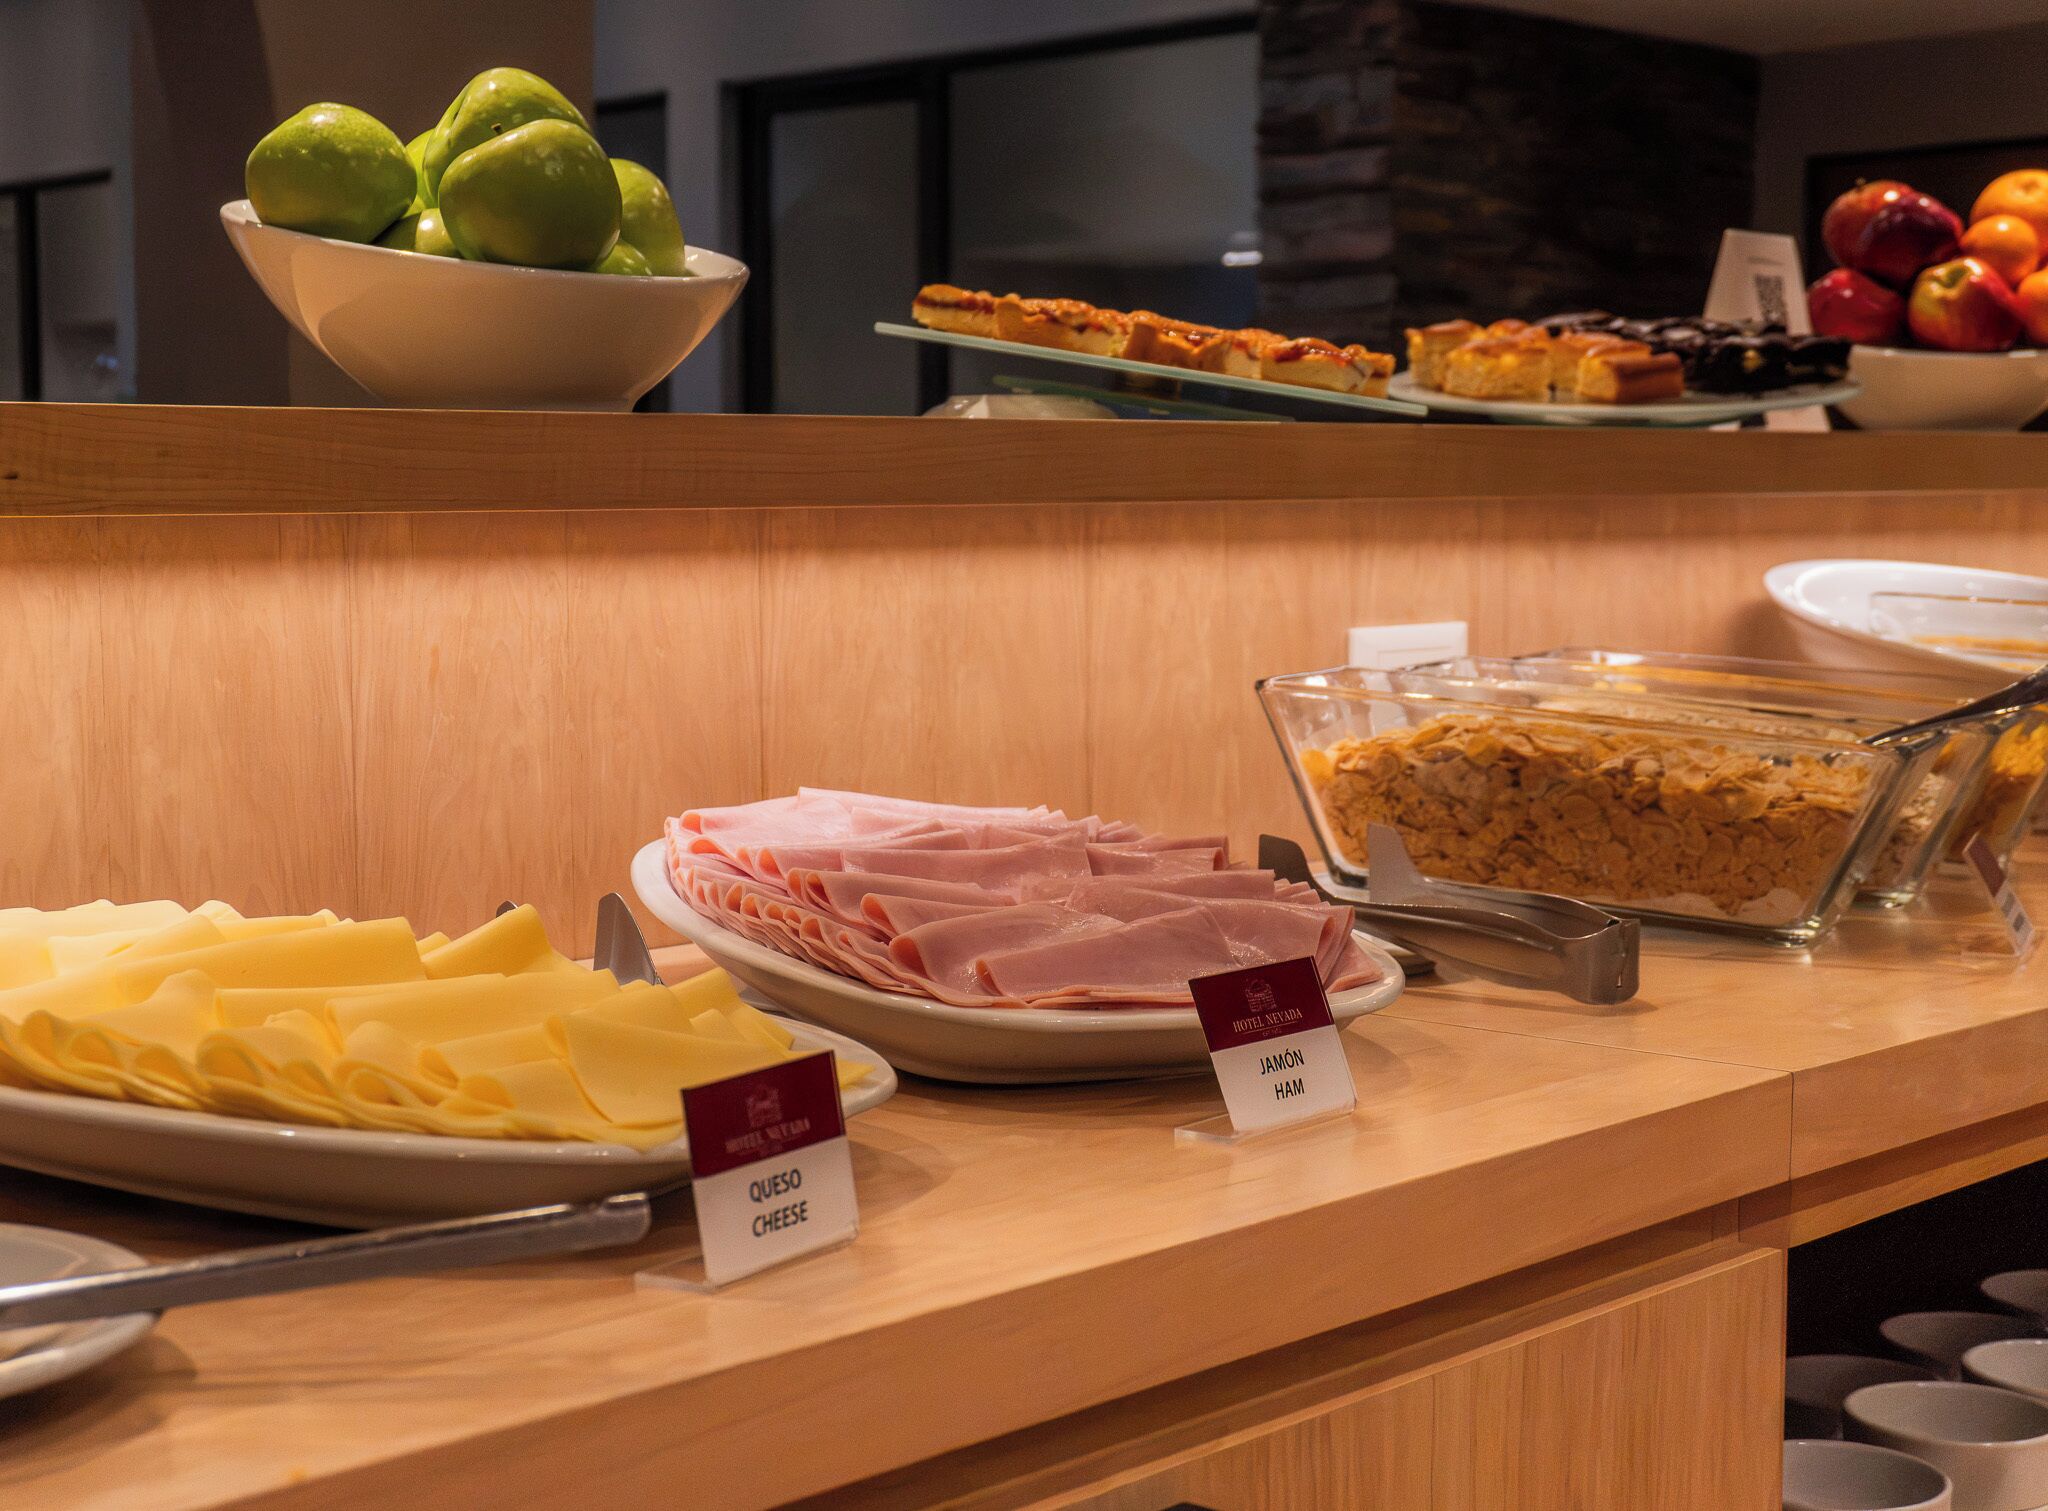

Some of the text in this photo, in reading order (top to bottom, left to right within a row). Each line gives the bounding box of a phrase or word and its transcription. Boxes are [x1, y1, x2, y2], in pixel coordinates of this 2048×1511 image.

[1232, 1016, 1264, 1032] HOTEL
[1266, 1008, 1303, 1024] NEVADA
[1260, 1048, 1304, 1075] JAMÓN
[1274, 1078, 1305, 1100] HAM
[749, 1168, 802, 1203] QUESO
[752, 1200, 808, 1237] CHEESE
